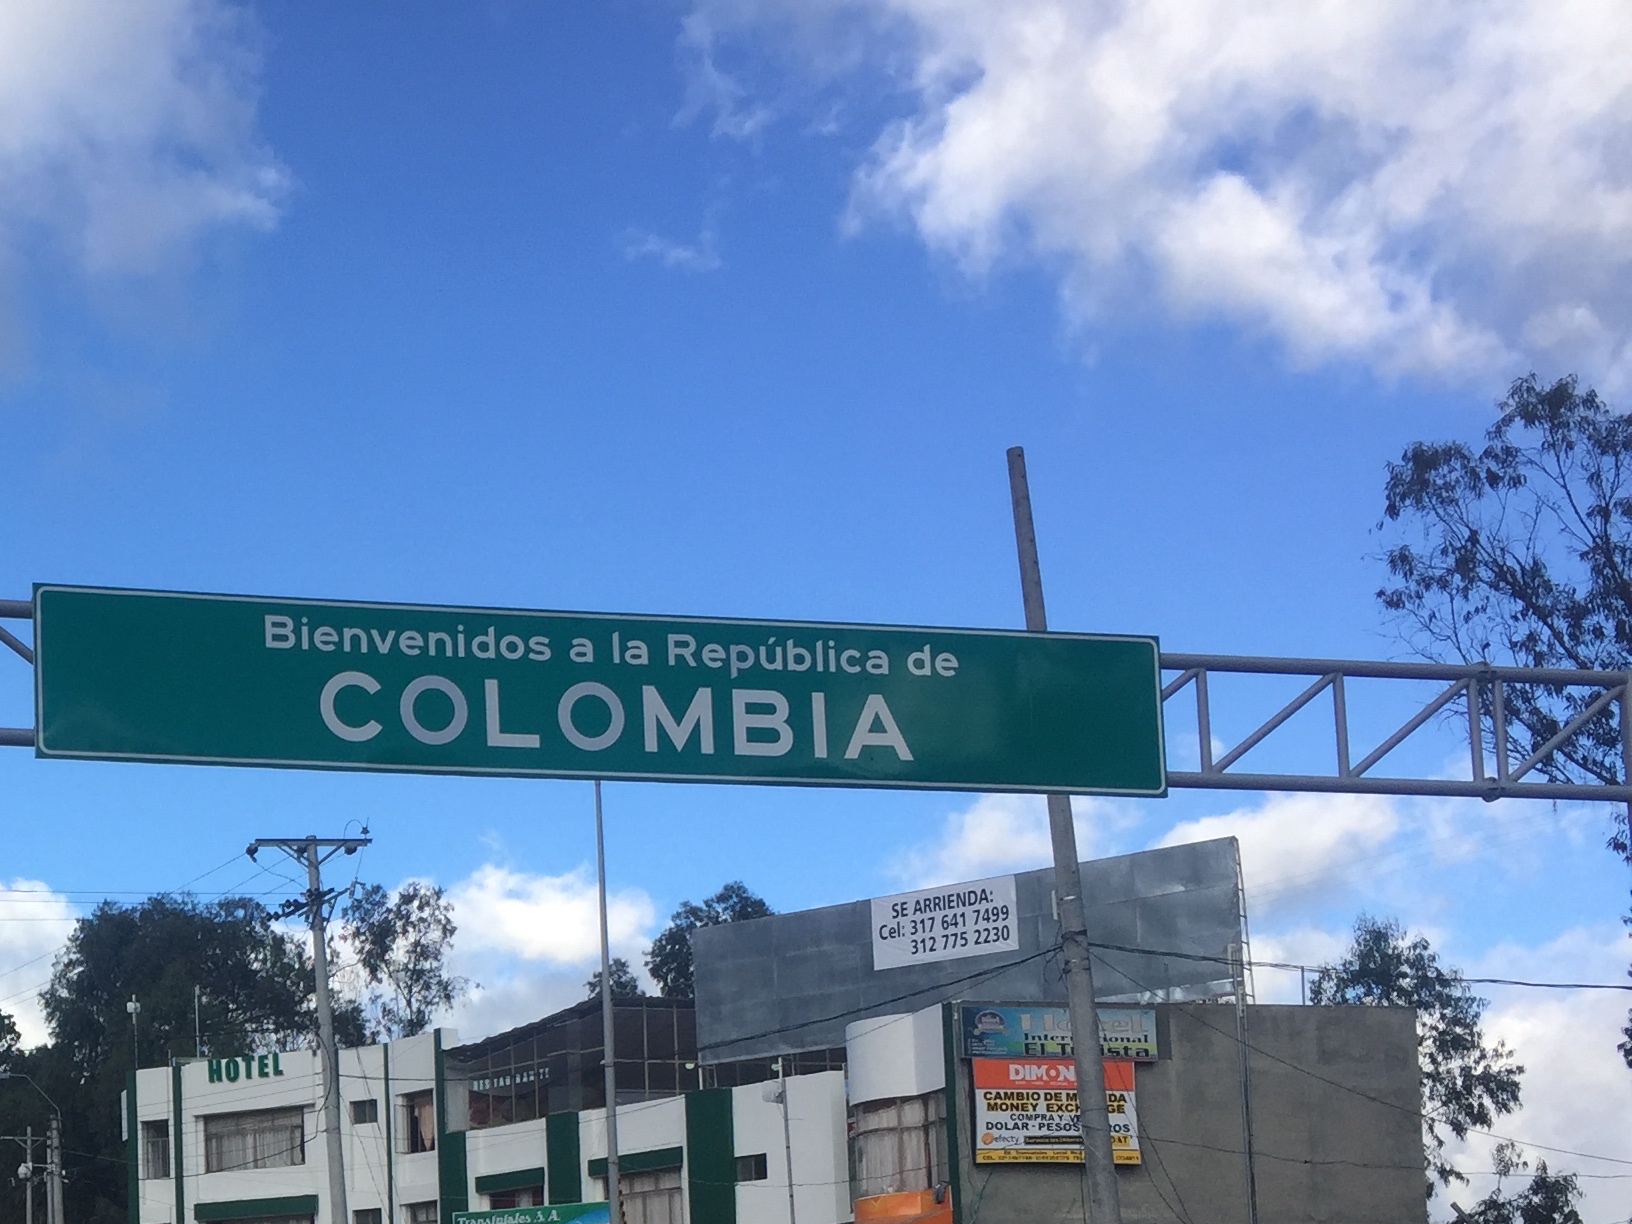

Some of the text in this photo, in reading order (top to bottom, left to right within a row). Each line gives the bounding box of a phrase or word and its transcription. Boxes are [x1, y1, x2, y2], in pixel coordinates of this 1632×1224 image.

[265, 614, 959, 679] Bienvenidos a la República de
[320, 671, 915, 761] COLOMBIA
[891, 888, 994, 919] SE ARRIENDA:
[879, 905, 1010, 940] Cel: 317 641 7499
[910, 925, 1010, 955] 312 775 2230
[1020, 1013, 1149, 1033] Hoel
[208, 1052, 284, 1083] HOTEL
[983, 1091, 1127, 1103] CAMBIO DE MDA
[986, 1102, 1039, 1113] MONEY
[986, 1121, 1029, 1131] DOLAR
[1038, 1122, 1080, 1132] PESOS
[1010, 1113, 1054, 1122] COMPRA
